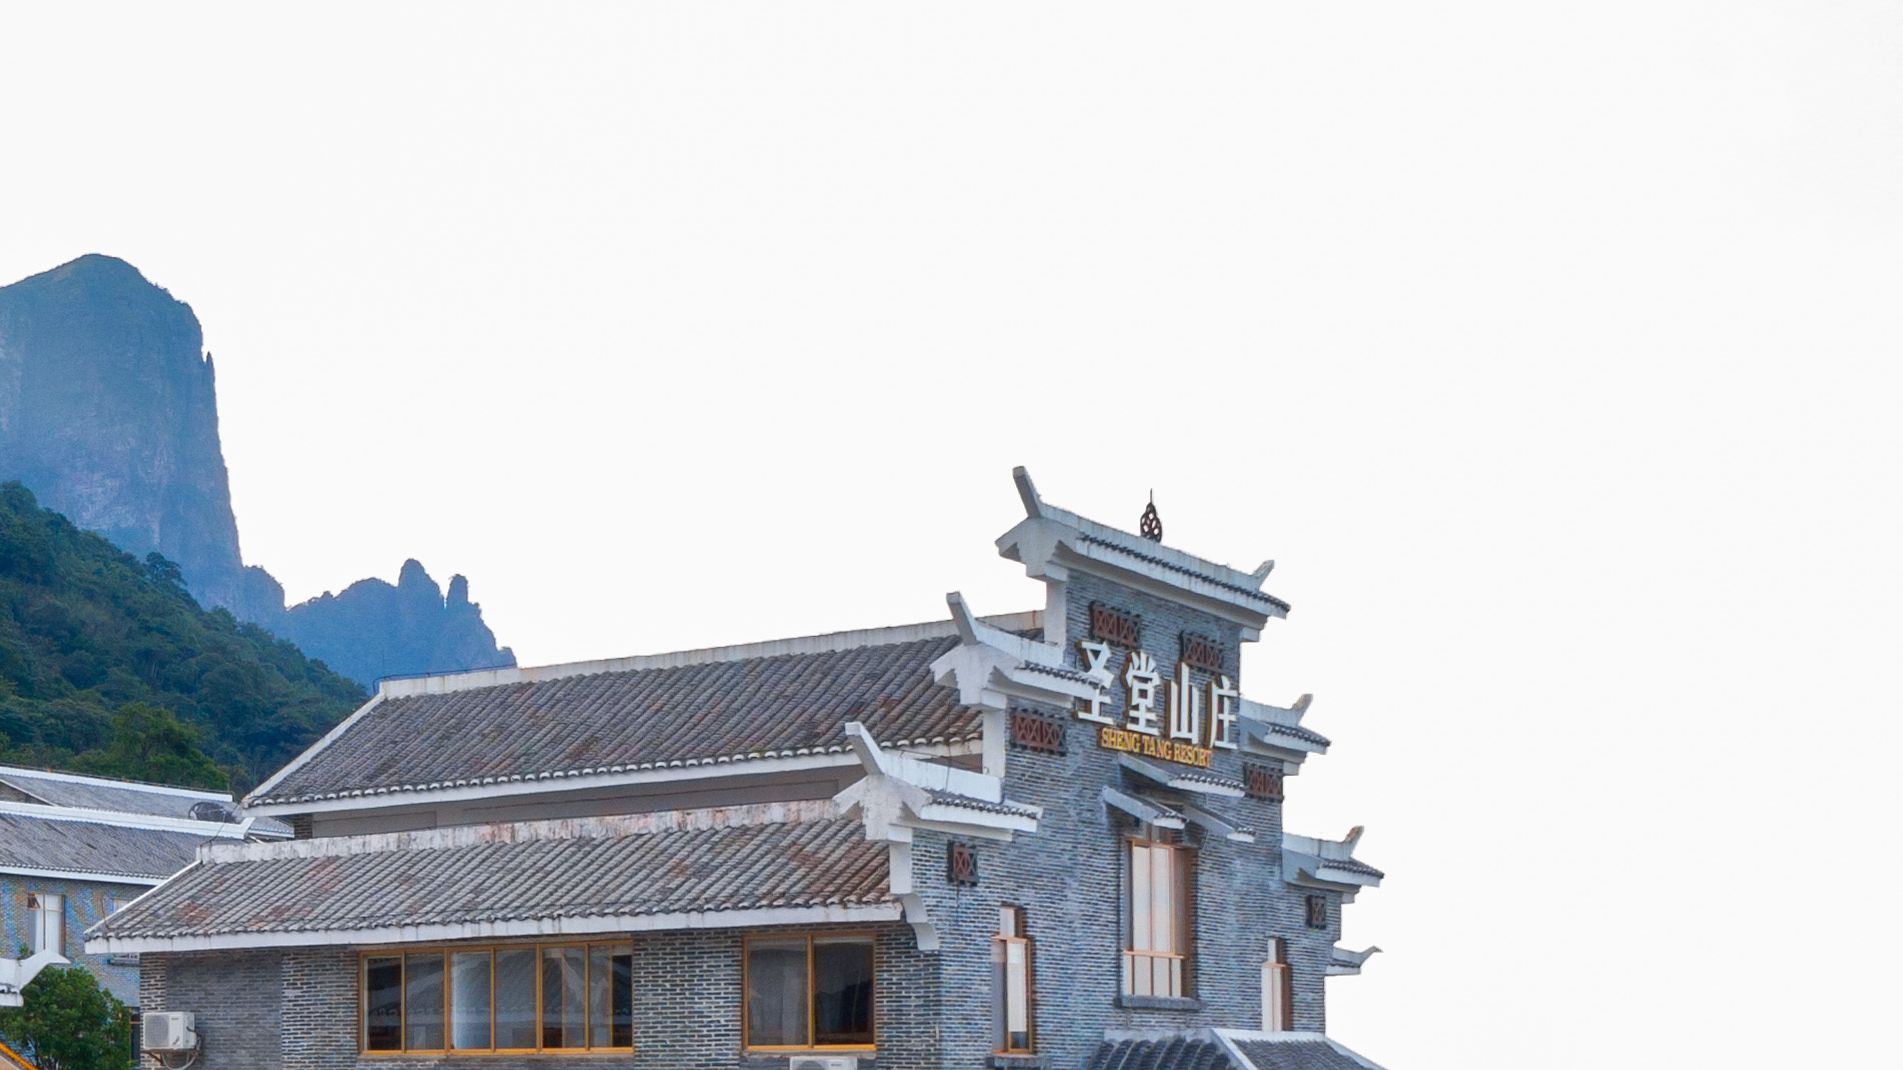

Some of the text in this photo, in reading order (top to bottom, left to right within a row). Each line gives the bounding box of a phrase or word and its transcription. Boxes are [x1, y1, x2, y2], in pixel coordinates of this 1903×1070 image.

[1077, 641, 1239, 749] 圣堂山庄
[1101, 728, 1212, 767] SHENG TANG RESORT
